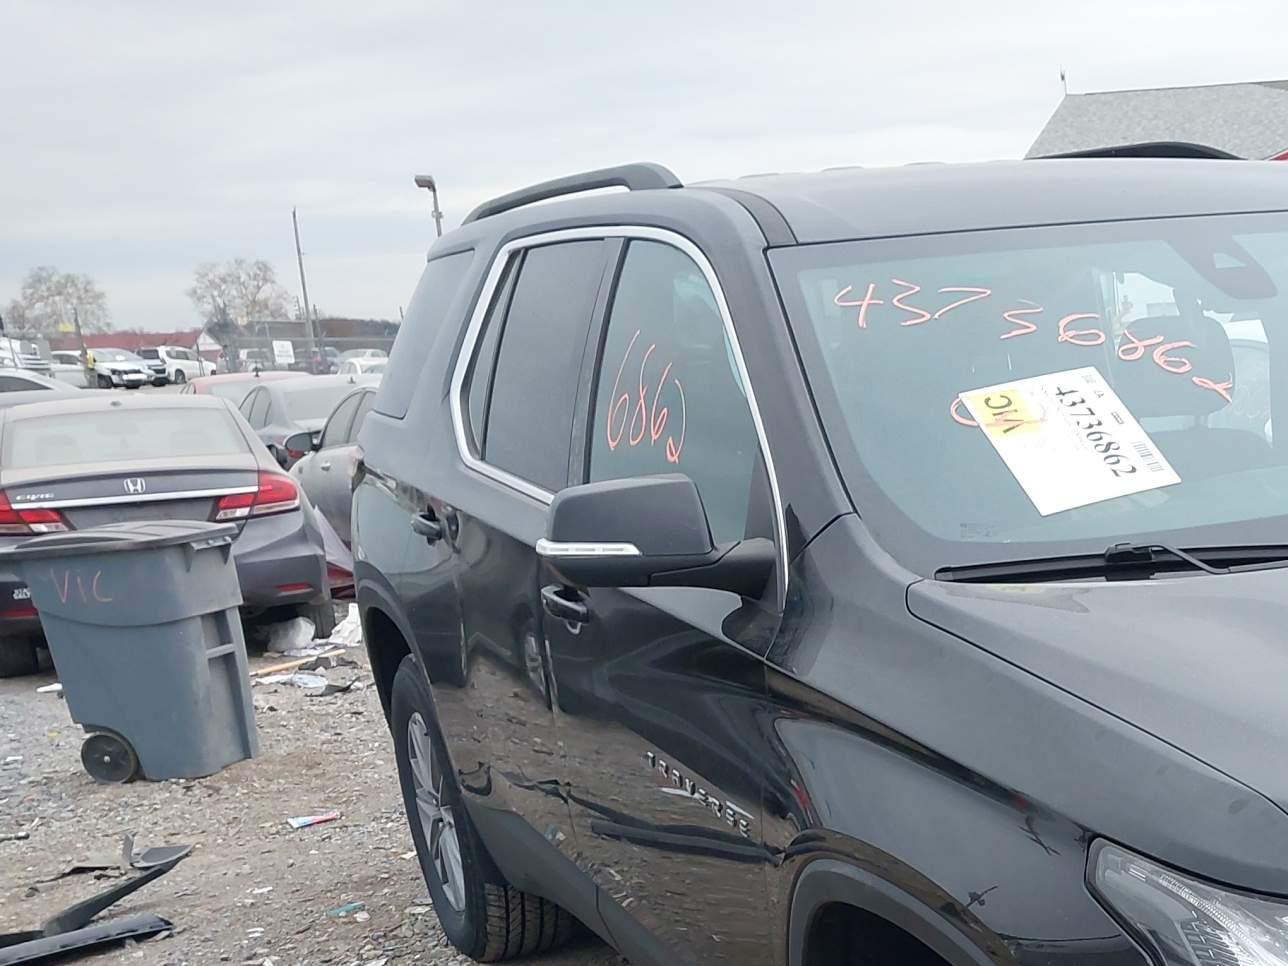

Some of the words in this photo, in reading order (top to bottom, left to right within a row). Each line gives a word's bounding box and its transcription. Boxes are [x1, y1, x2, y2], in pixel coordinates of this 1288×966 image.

[606, 328, 687, 465] 6862
[1055, 385, 1138, 478] 43736862
[642, 750, 752, 839] TRAVERSE
